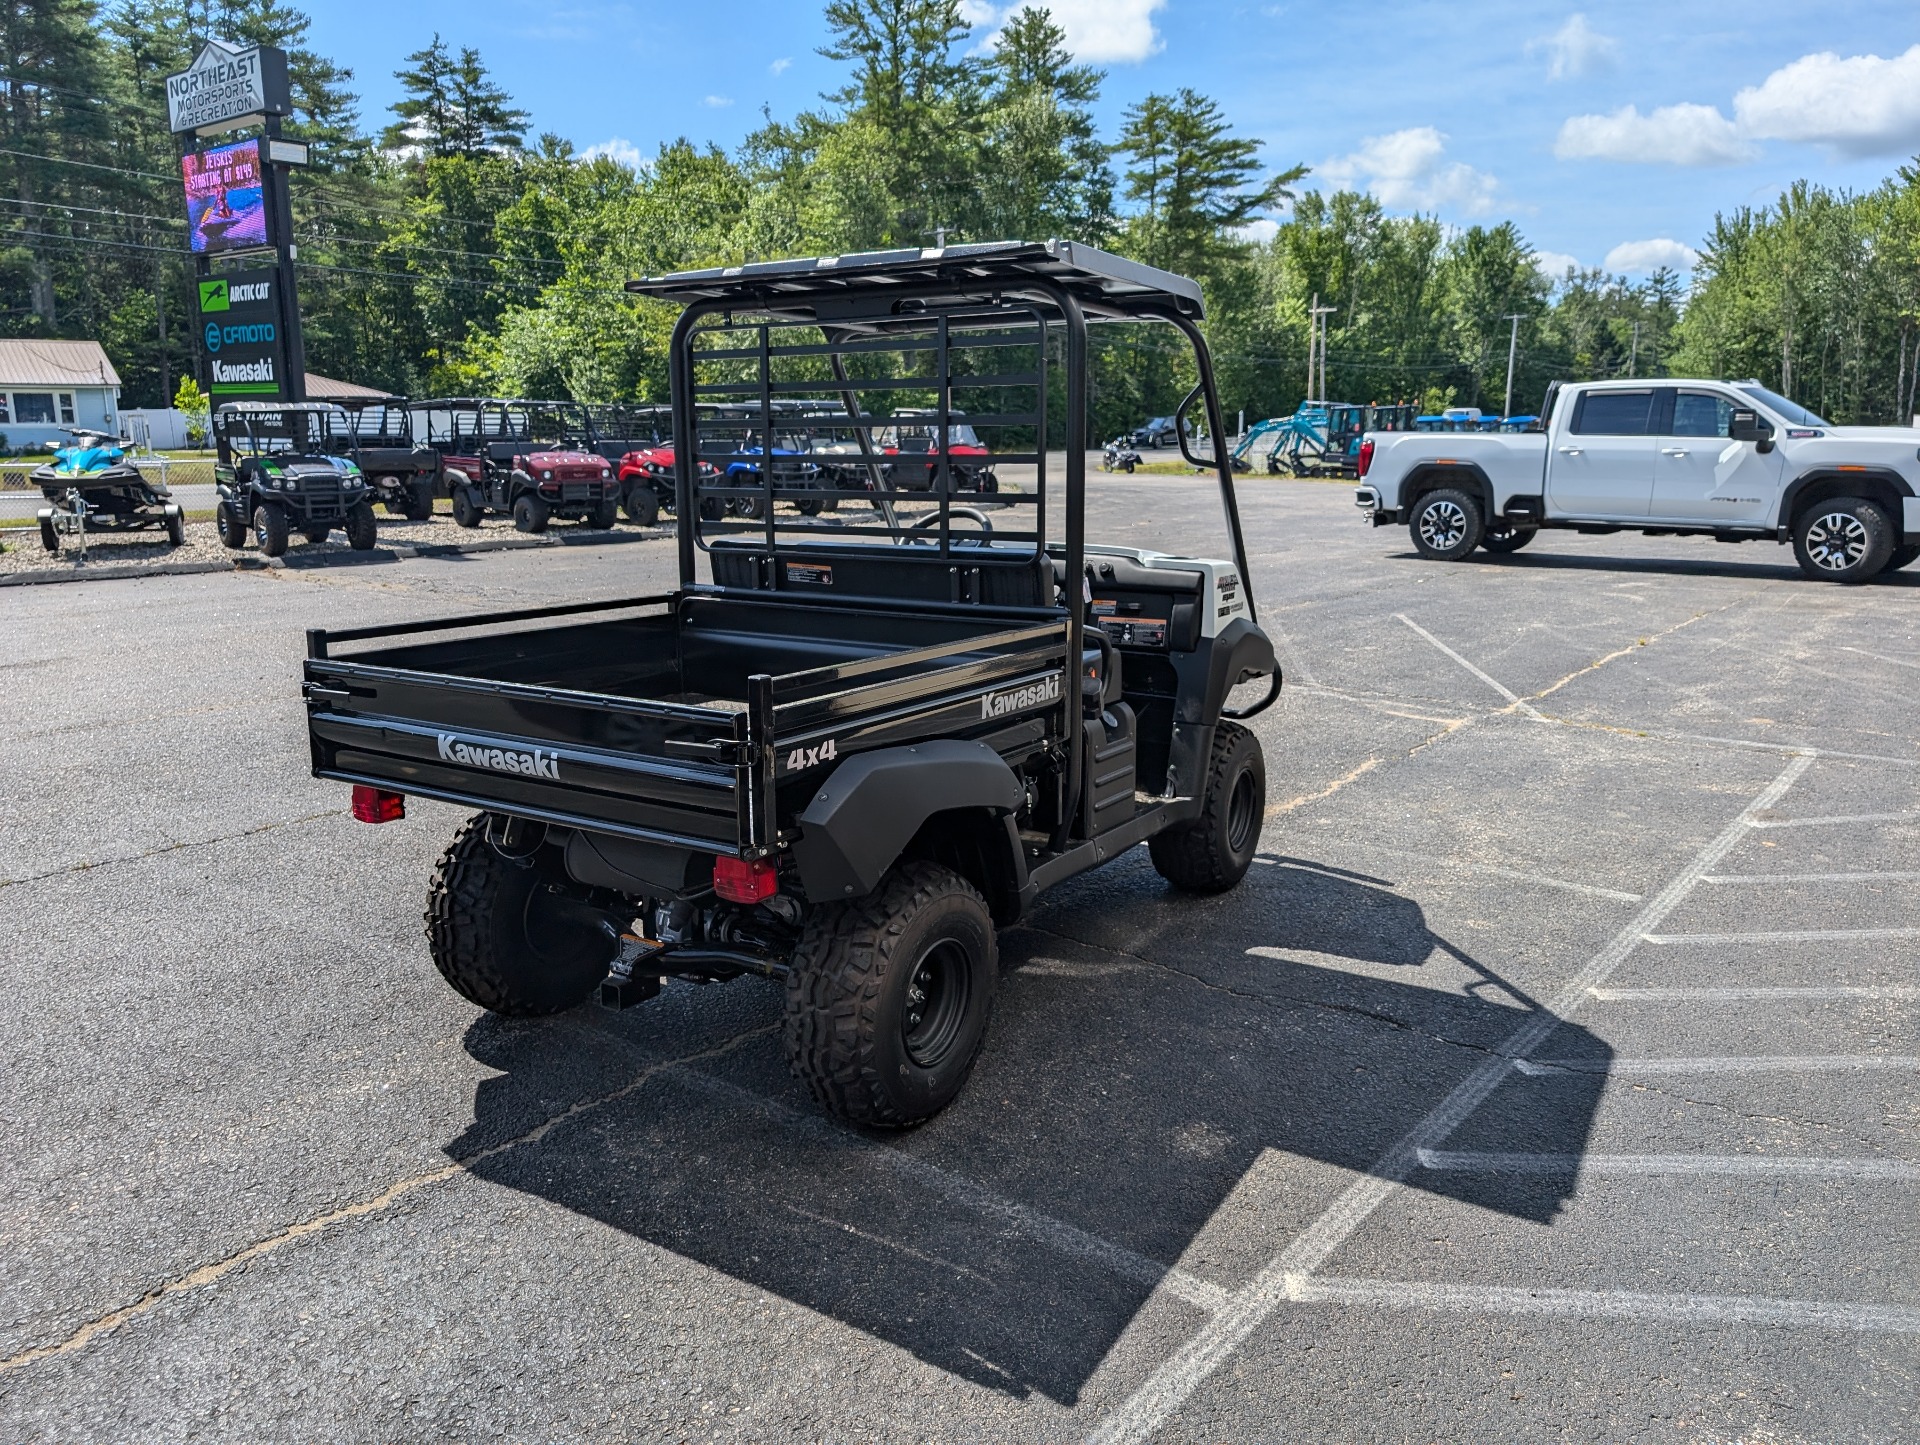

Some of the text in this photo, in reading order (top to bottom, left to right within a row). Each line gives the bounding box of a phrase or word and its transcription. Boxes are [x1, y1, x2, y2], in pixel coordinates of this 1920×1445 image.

[169, 54, 256, 98] NORTHEAST
[177, 79, 253, 113] MOTORSPORTS
[182, 97, 252, 126] & RECREATION
[205, 151, 233, 169] JETSKIS
[190, 163, 253, 189] STARTING AT $149
[230, 282, 270, 302] ARCTIC CAT
[223, 323, 275, 344] CFMOTO
[212, 358, 274, 382] Kawasaki
[981, 675, 1060, 720] Kawasaki
[437, 733, 561, 780] Kawasaki
[786, 739, 838, 771] 4x4
